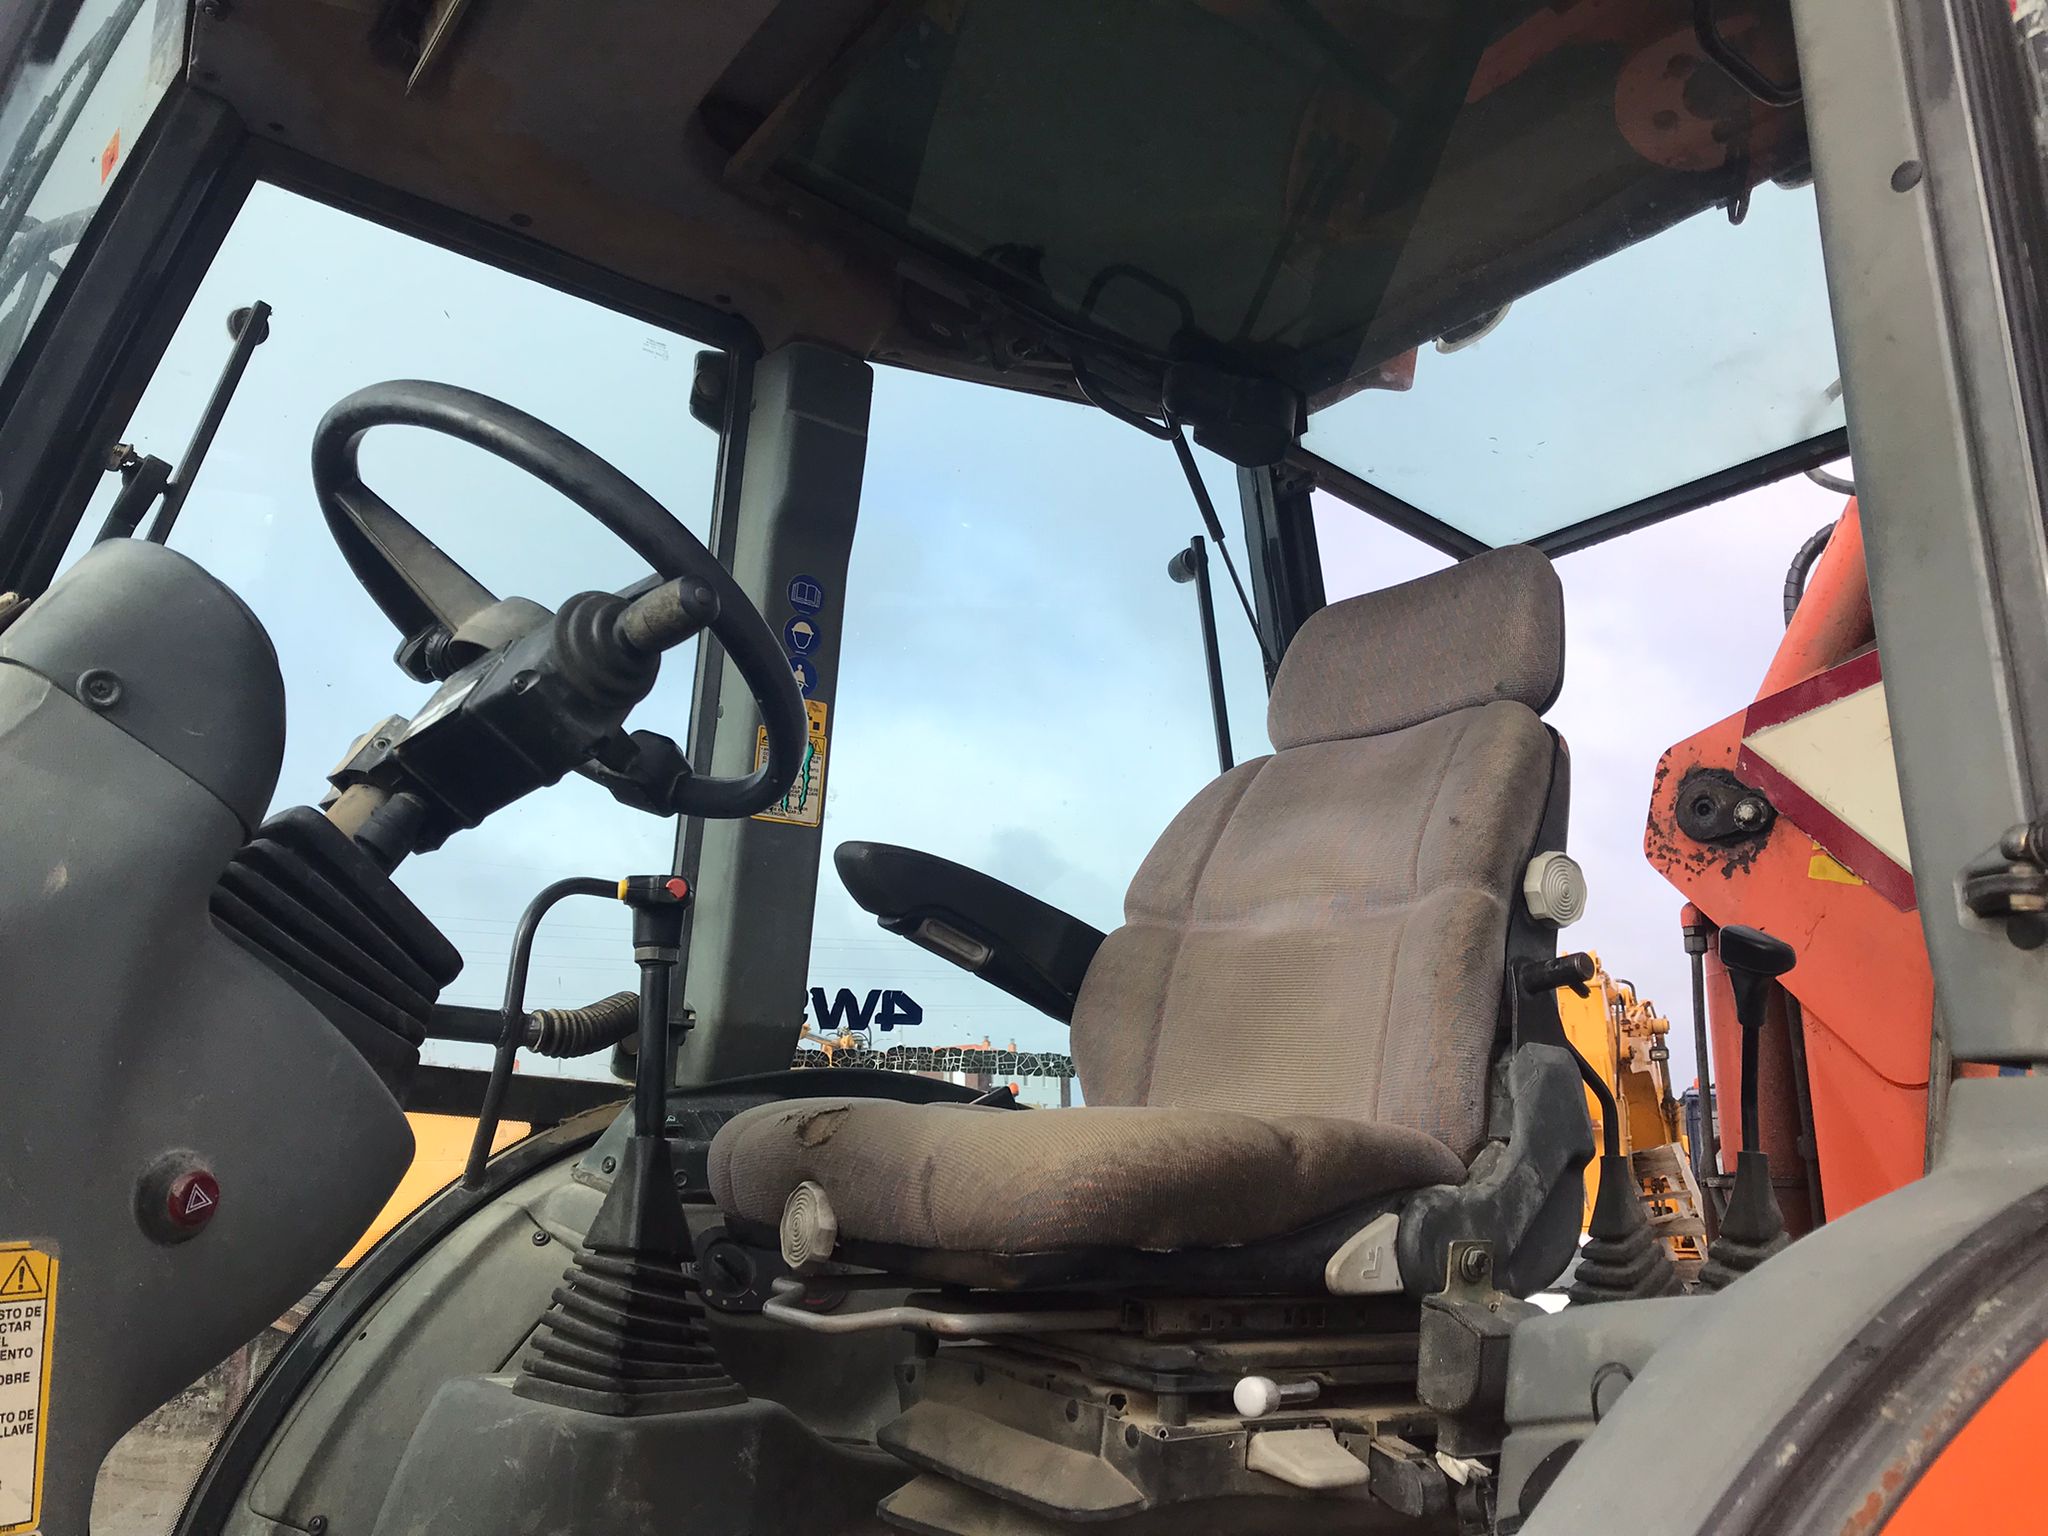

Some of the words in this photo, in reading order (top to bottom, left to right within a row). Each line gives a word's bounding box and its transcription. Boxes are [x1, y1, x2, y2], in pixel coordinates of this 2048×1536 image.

[25, 1306, 42, 1318] DE
[0, 1320, 31, 1334] CTAR
[0, 1347, 33, 1361] ENTO
[18, 1409, 34, 1421] DE
